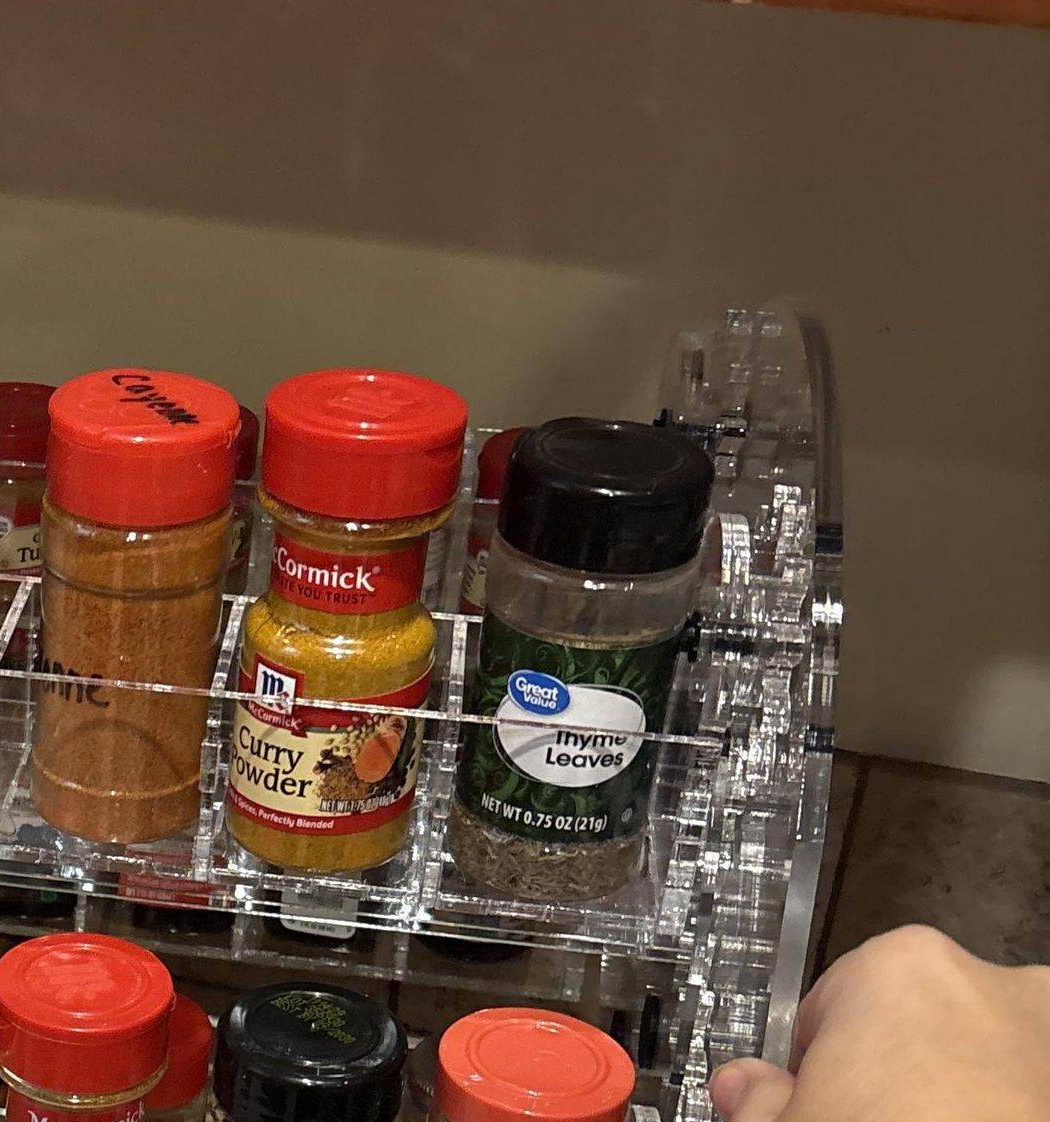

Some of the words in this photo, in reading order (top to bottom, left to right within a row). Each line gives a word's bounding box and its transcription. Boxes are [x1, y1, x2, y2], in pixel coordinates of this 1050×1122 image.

[298, 583, 321, 600] YOU
[326, 590, 368, 605] TRUST
[515, 677, 559, 699] Great
[523, 692, 556, 709] Value
[248, 702, 301, 730] McCormick
[239, 725, 304, 775] Curry
[546, 747, 624, 768] Leaves
[258, 809, 295, 828] Perfectly
[297, 818, 334, 829] Blended
[482, 793, 502, 814] NET
[502, 803, 522, 823] WT
[524, 812, 551, 829] 0.75
[555, 816, 574, 830] OZ
[575, 815, 607, 832] (21g)
